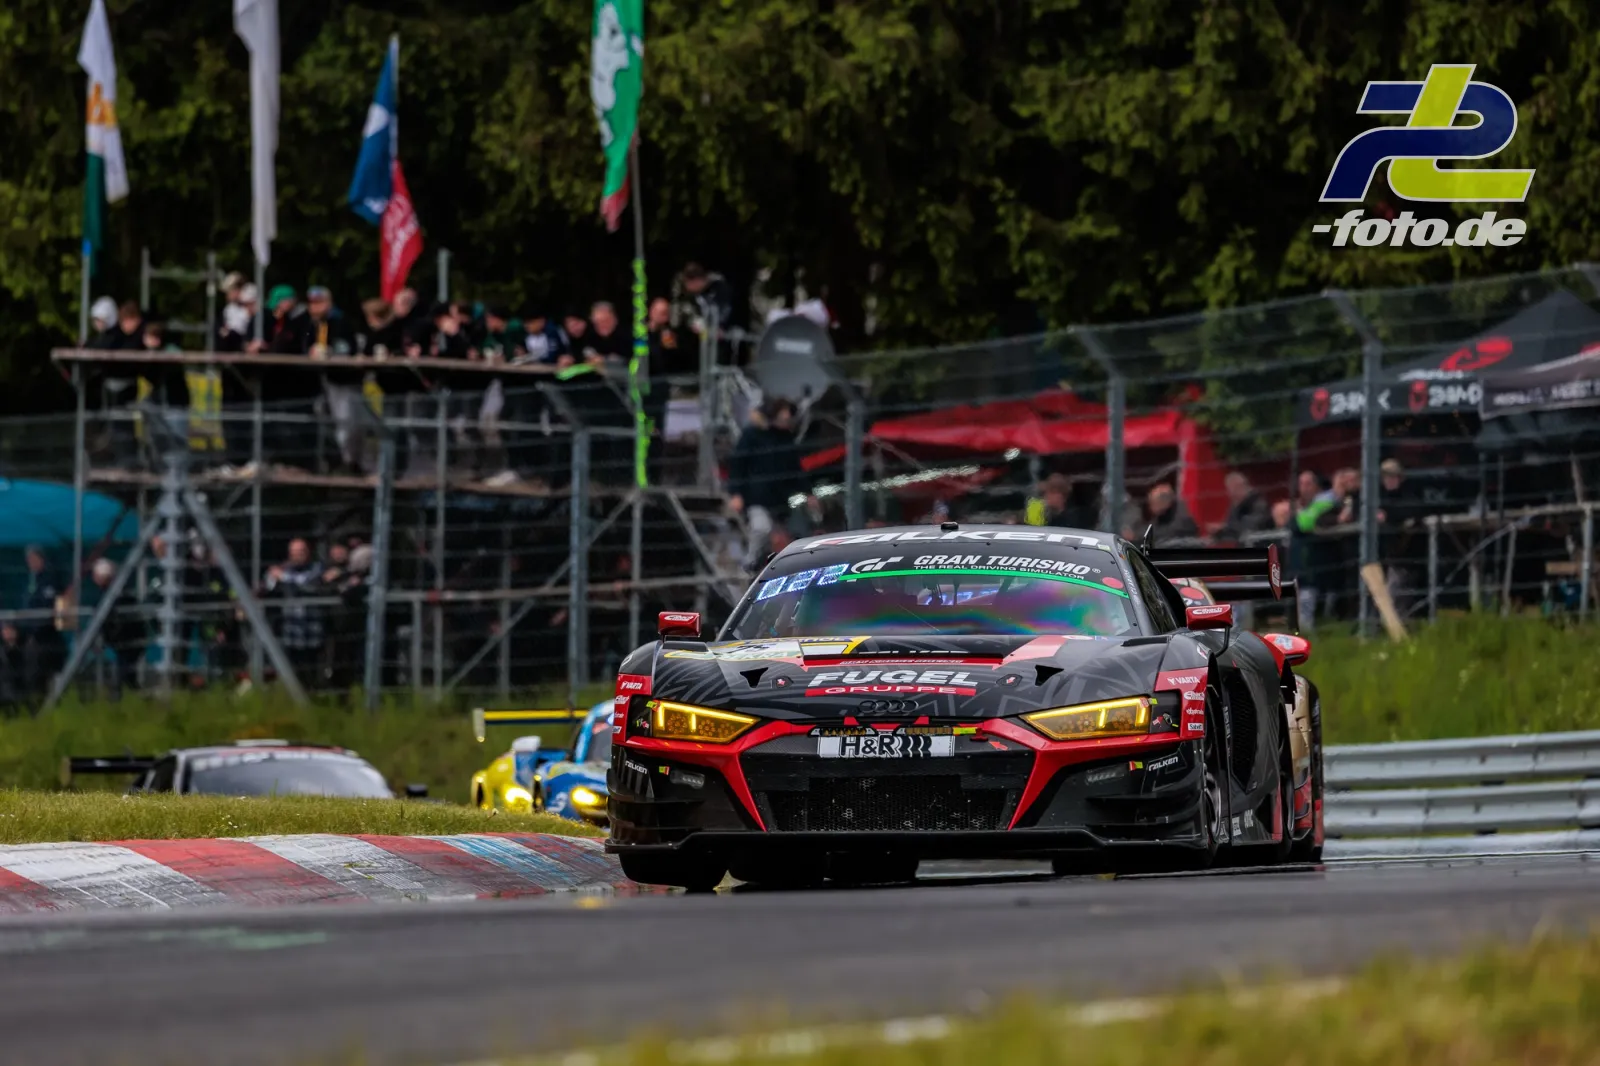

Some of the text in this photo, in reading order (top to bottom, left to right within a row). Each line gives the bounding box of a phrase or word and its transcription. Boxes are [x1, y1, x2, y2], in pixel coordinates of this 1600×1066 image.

[803, 531, 1100, 549] FALKEN
[914, 555, 982, 565] GRAN
[1019, 567, 1085, 580] SIMULATOR
[808, 670, 978, 688] FUGEL
[1175, 676, 1201, 685] VARTA
[825, 685, 957, 694] GRUPPE
[841, 735, 896, 757] H&R
[625, 760, 648, 774] FALKEN
[1148, 757, 1179, 771] FALKEN
